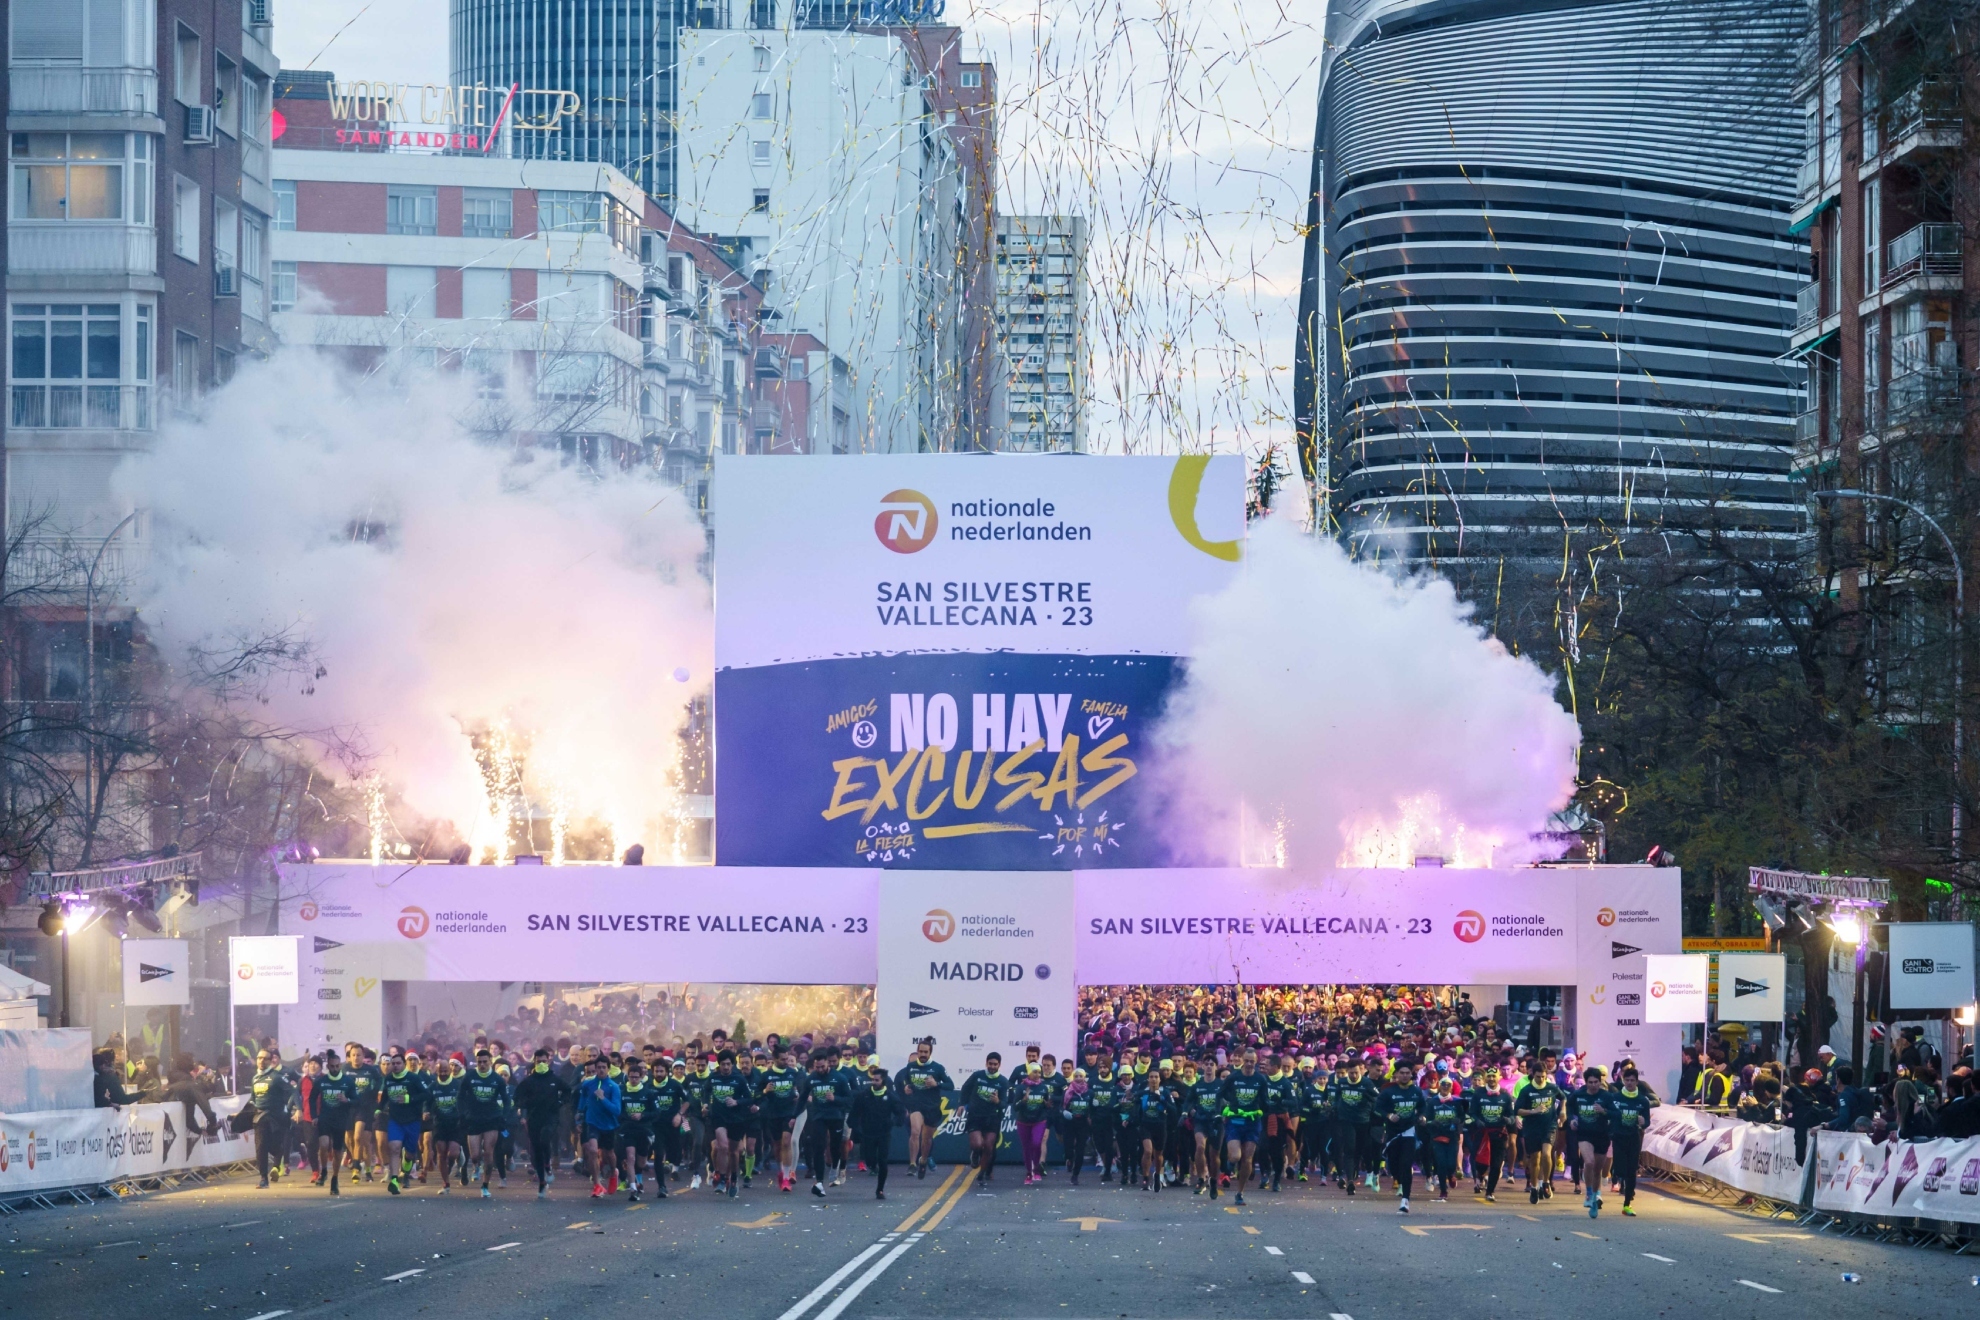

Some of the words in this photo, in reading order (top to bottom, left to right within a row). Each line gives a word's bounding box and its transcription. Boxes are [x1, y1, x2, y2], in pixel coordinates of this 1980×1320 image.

[327, 80, 408, 123] WORK
[421, 81, 488, 127] CAFÉ
[336, 129, 479, 149] SANTANDER
[951, 498, 1055, 517] nationale
[951, 521, 1092, 540] nederlanden
[877, 581, 932, 602] SAN
[943, 581, 1092, 602] SILVESTRE
[877, 605, 1038, 626] VALLECANA
[1062, 606, 1093, 626] 23
[826, 698, 878, 733] AMIGOS
[890, 693, 959, 752] NO
[972, 693, 1072, 752] HAY
[821, 733, 1138, 826] EXCUSAS
[856, 839, 870, 854] LA
[875, 834, 915, 850] FIESTA
[1058, 826, 1087, 844] POR
[435, 911, 488, 921] nationale
[527, 914, 570, 931] SAN
[577, 914, 690, 932] SILVESTRE
[697, 915, 825, 933] VALLECANA
[843, 917, 868, 933] 23
[961, 914, 1016, 925] nationale
[1090, 918, 1133, 934] SAN
[1140, 918, 1254, 934] SILVESTRE
[1261, 917, 1388, 934] VALLECANA
[1407, 918, 1432, 934] 23
[1492, 914, 1545, 925] nationale
[435, 922, 507, 933] nederlanden
[961, 927, 1034, 938] nederlanden
[1492, 926, 1564, 938] nederlanden
[314, 967, 345, 975] Polestar
[930, 961, 1024, 981] MADRID
[1612, 973, 1643, 981] Polestar
[958, 1007, 994, 1016] Polestar
